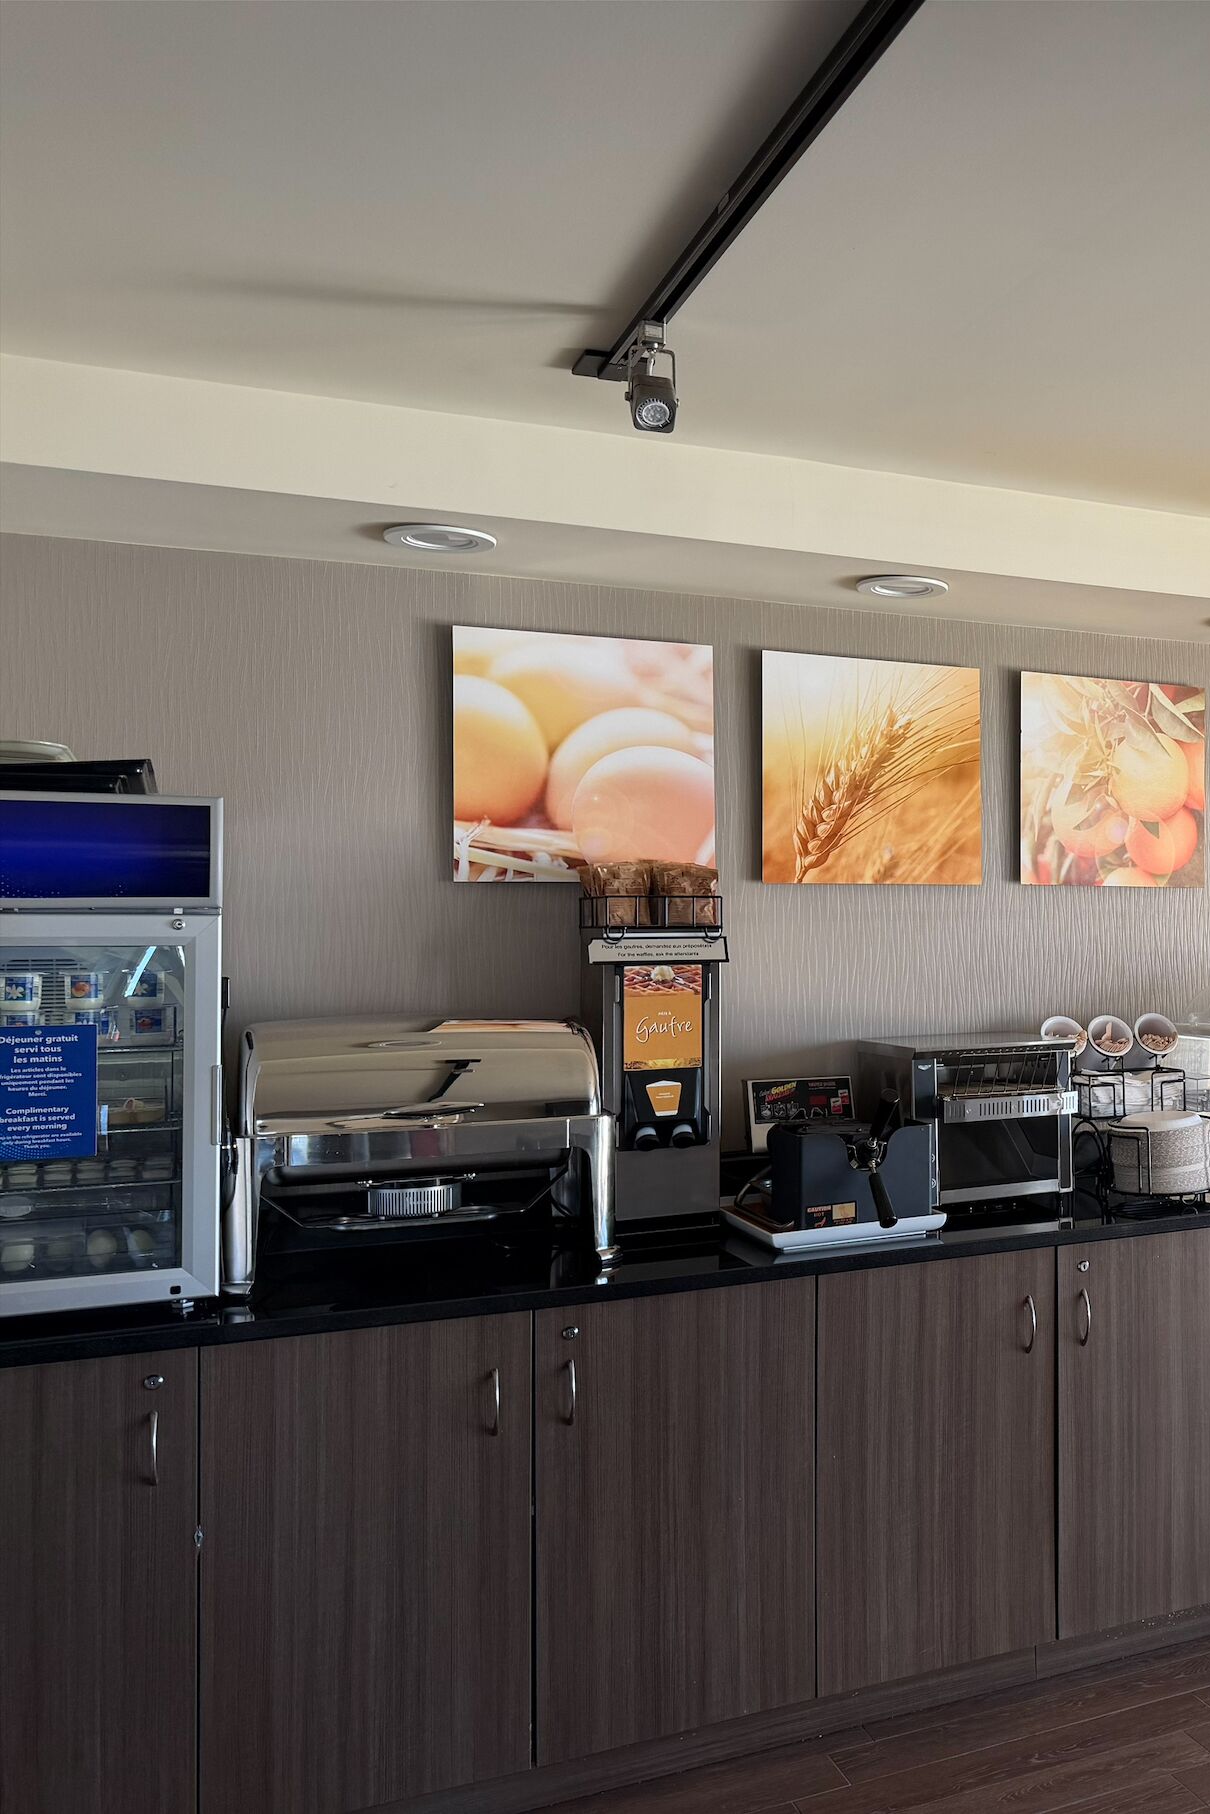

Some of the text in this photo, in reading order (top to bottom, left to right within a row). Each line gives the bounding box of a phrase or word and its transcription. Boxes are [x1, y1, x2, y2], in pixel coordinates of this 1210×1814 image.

[635, 1016, 693, 1043] Gaufre
[0, 1034, 79, 1046] Déjeuner gratuit
[14, 1045, 62, 1054] servi tous
[13, 1054, 63, 1064] les matins
[5, 1106, 70, 1116] Complimentary
[0, 1113, 76, 1124] breakfast is served
[7, 1122, 68, 1133] every morning
